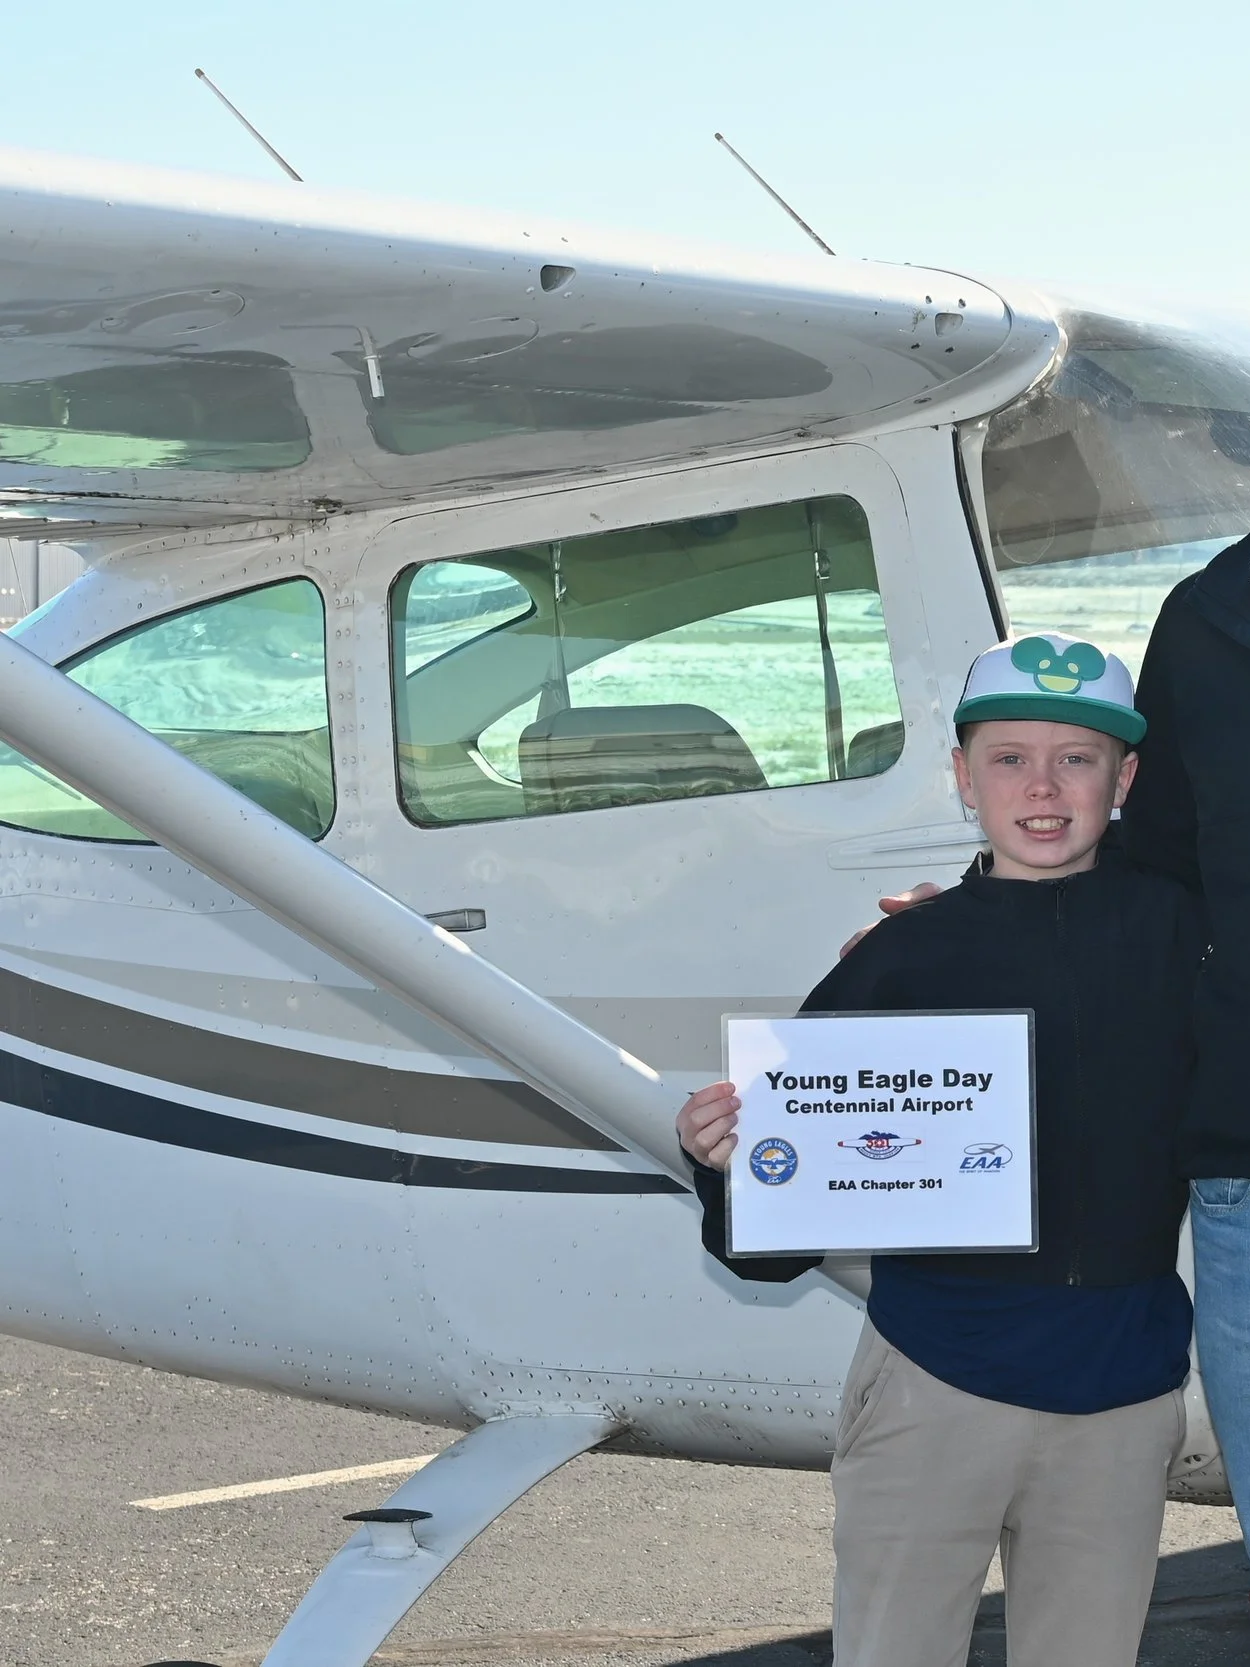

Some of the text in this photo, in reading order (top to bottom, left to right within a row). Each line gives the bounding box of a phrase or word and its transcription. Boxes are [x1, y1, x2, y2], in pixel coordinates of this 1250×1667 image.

[765, 1068, 993, 1094] Young Eagle Day
[785, 1096, 973, 1115] Centennial Airport
[754, 1140, 793, 1156] YOUNG EAGLES
[959, 1156, 1002, 1169] EAA
[828, 1178, 943, 1192] EAA Chapter 301
